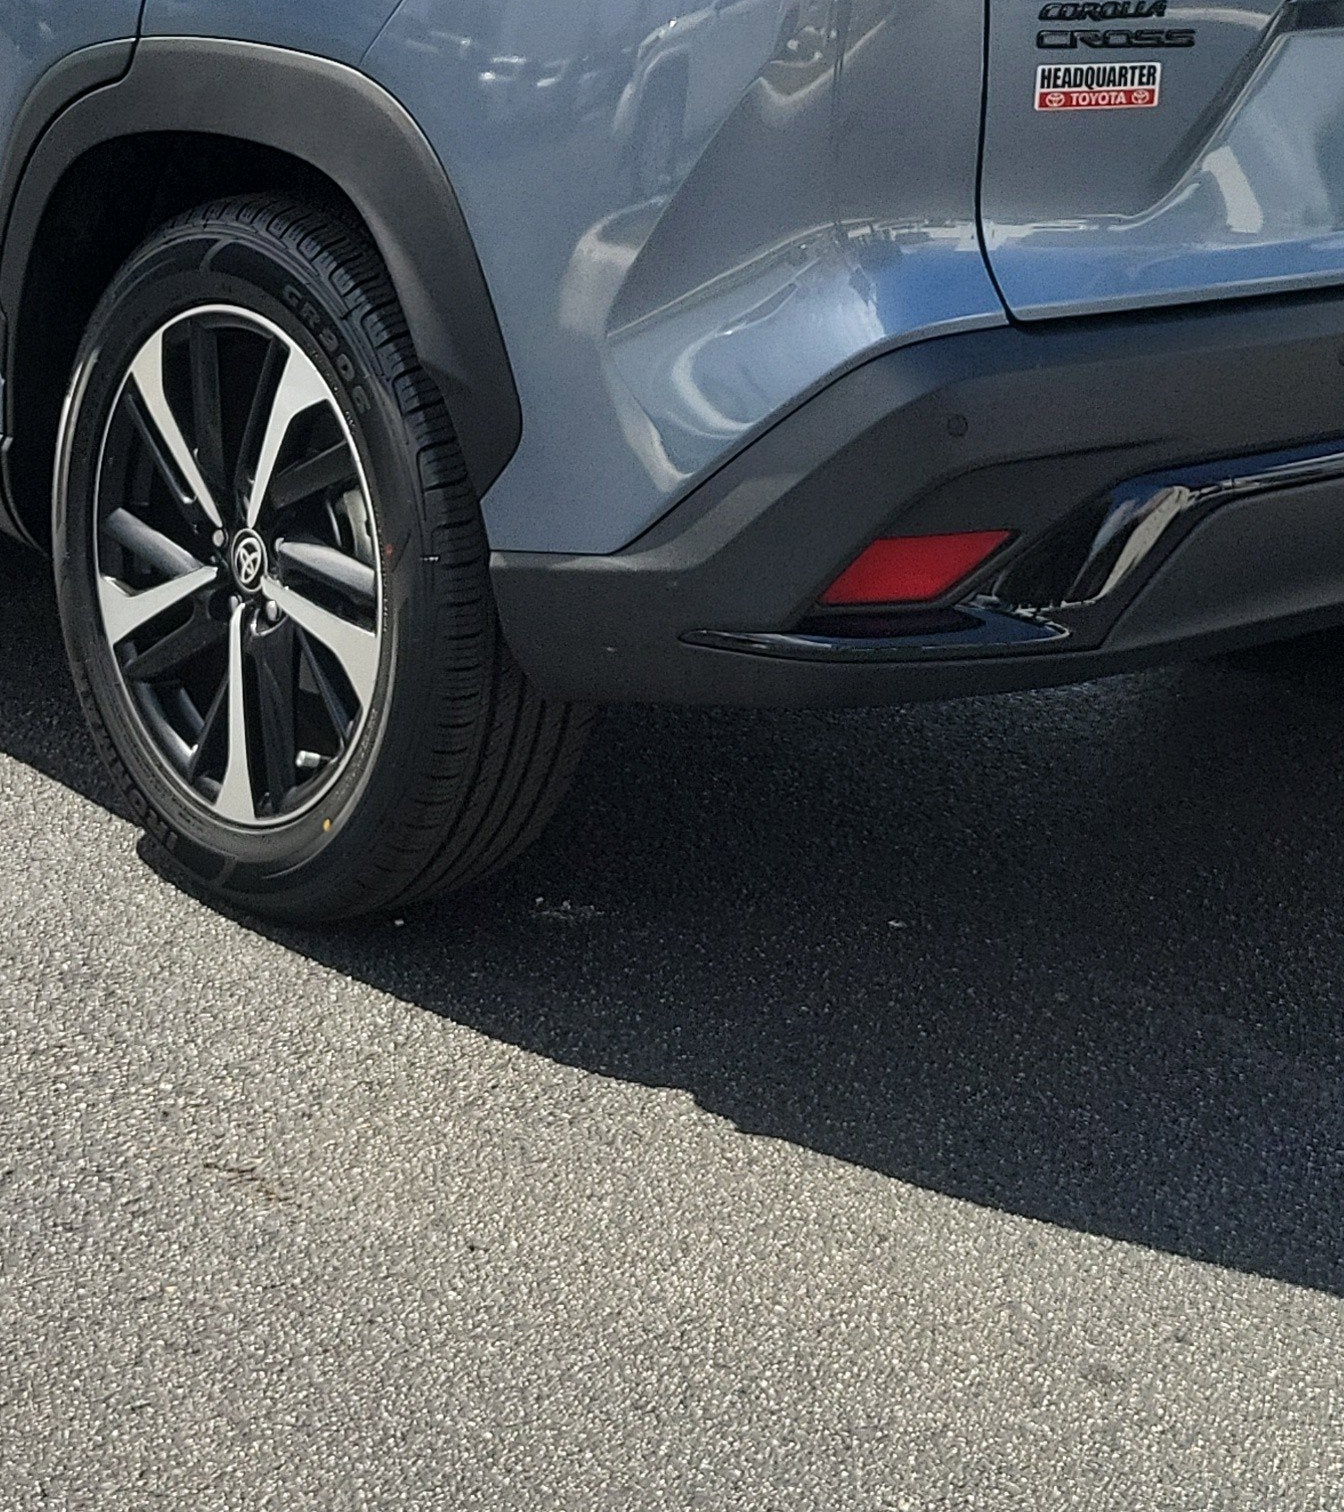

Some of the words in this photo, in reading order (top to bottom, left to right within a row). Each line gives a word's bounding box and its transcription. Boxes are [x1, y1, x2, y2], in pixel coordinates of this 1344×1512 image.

[1038, 0, 1168, 21] COROLLA
[1036, 28, 1196, 49] CROSS
[1040, 64, 1157, 90] HEADQUARTER
[1070, 91, 1128, 106] TOYOTA
